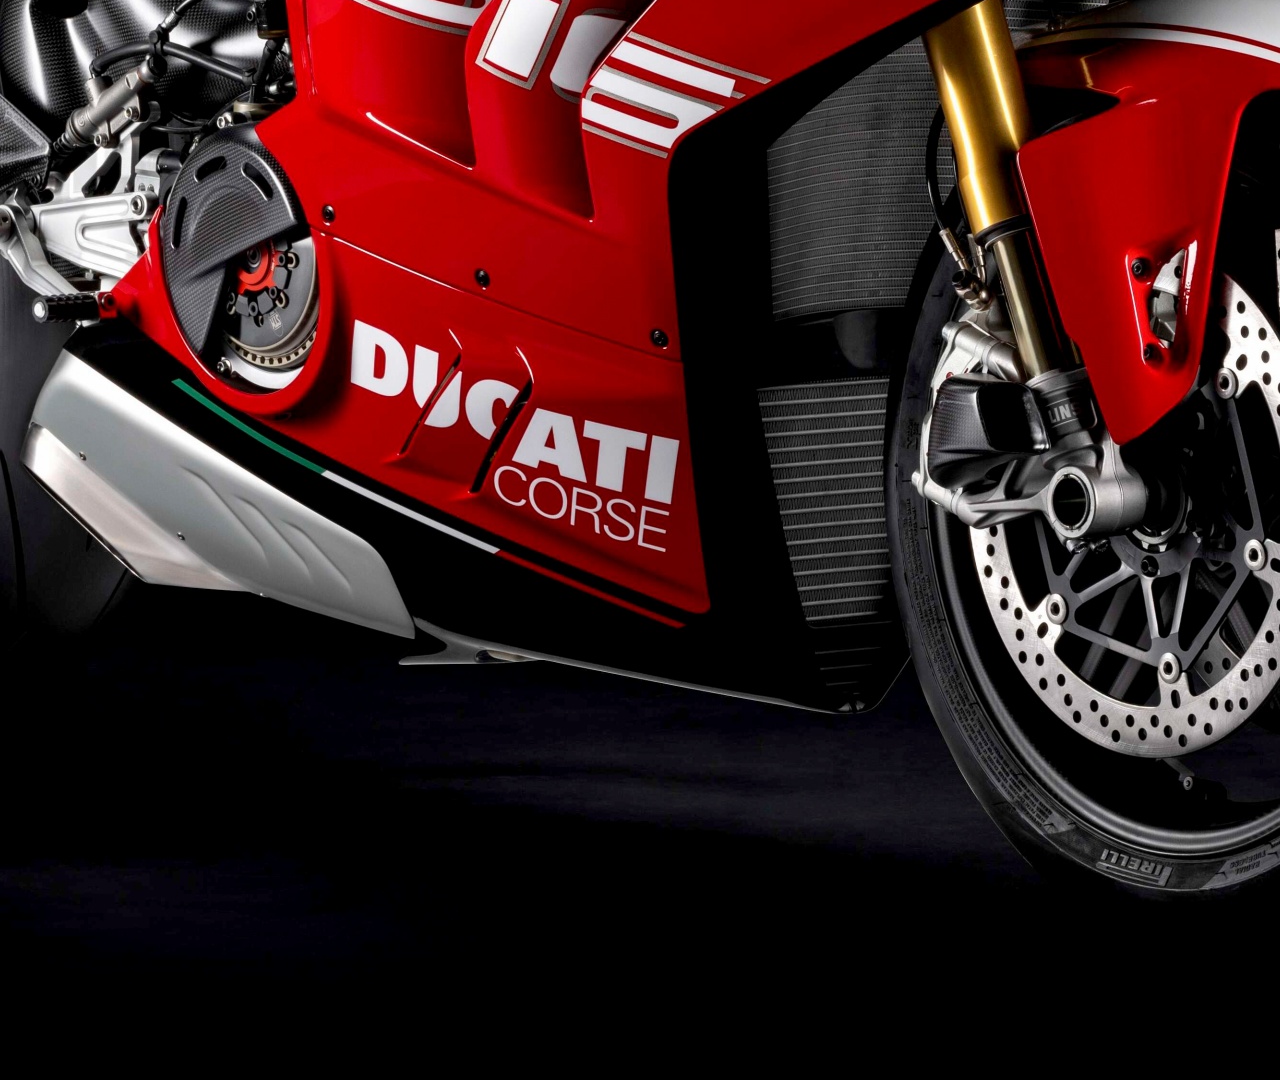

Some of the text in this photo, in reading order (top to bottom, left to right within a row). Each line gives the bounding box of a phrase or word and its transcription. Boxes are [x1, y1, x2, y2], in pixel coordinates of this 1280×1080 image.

[350, 319, 680, 505] DUCATI
[493, 466, 670, 553] CORSE
[1096, 848, 1174, 888] PIRELLI
